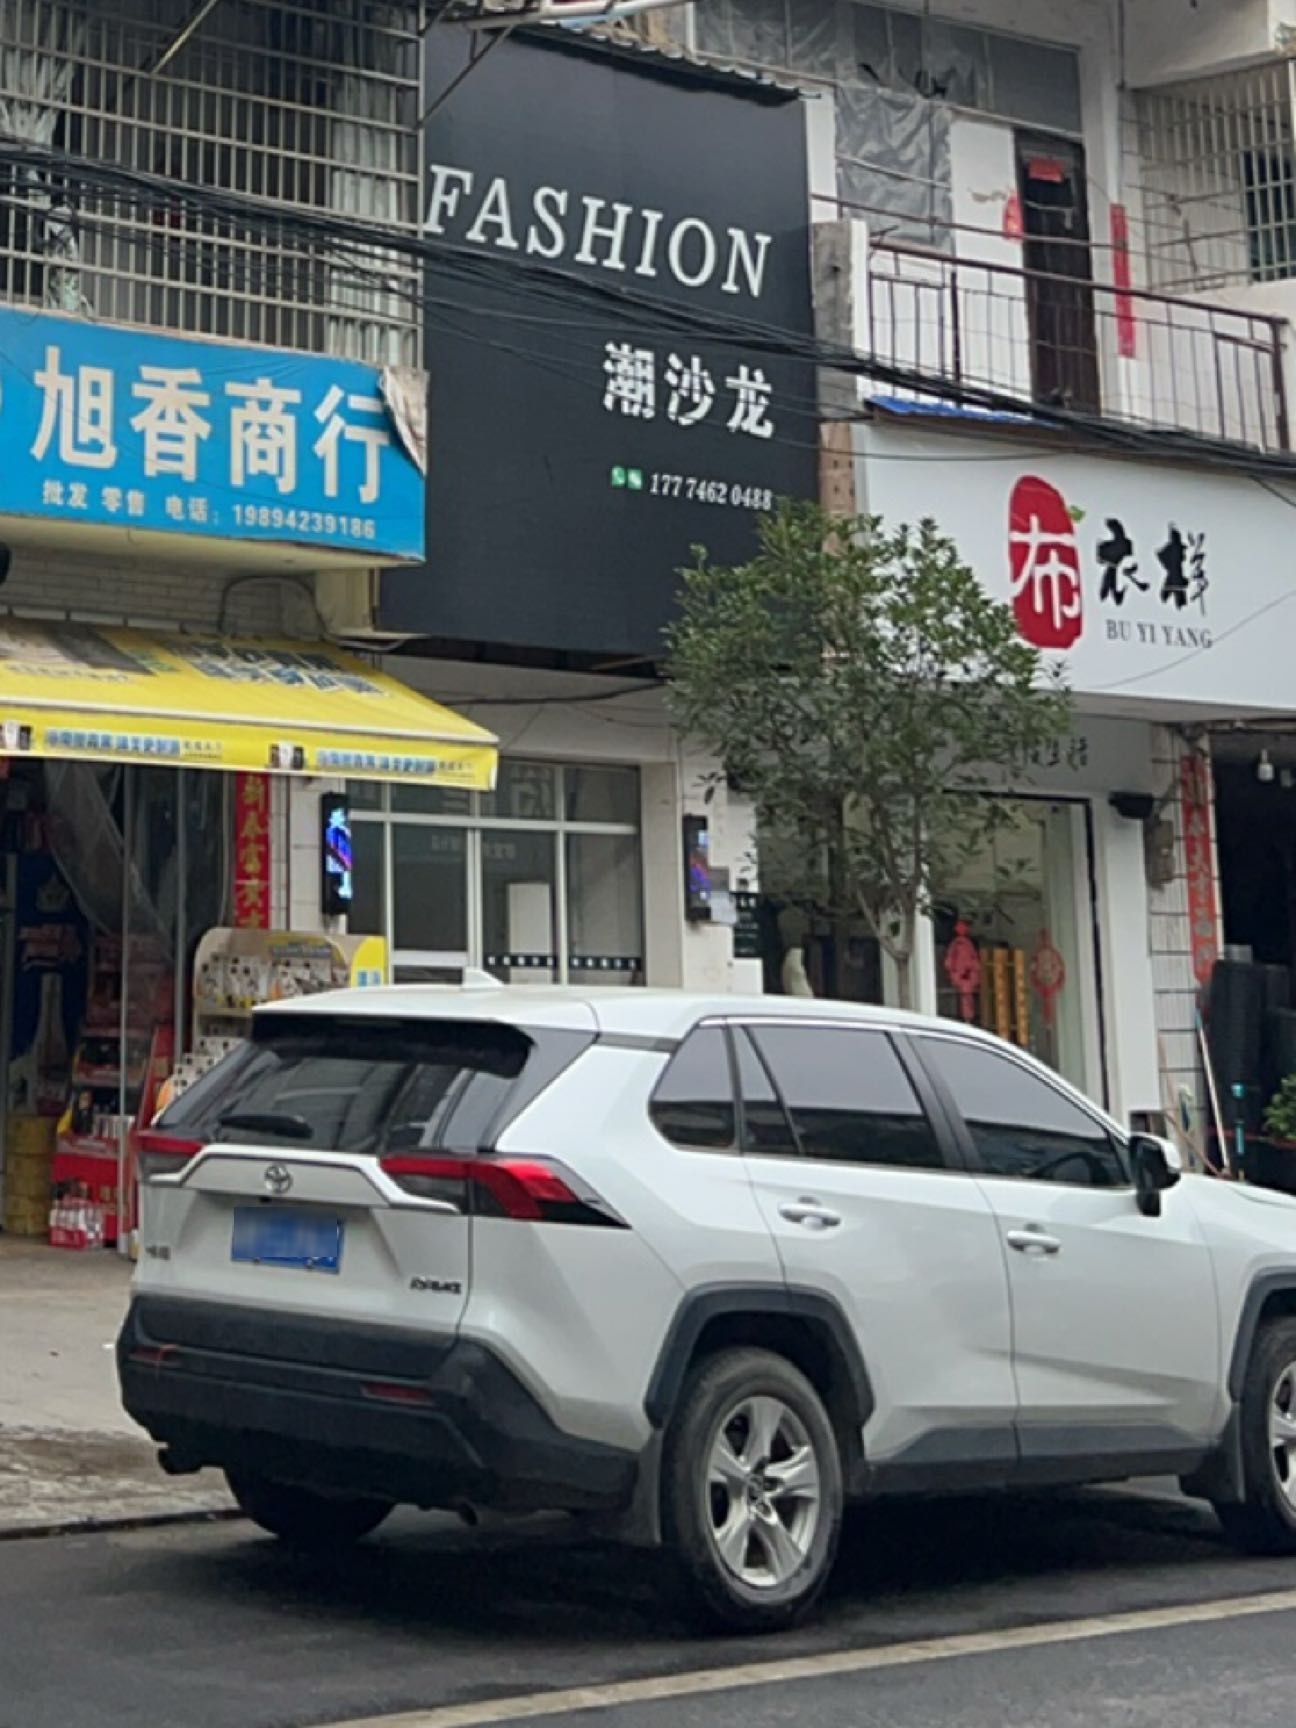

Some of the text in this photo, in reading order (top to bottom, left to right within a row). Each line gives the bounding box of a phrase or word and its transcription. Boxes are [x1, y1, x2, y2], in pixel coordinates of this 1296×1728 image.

[423, 164, 773, 298] FASHION
[30, 345, 390, 504] 旭香商行
[604, 341, 775, 439] 潮沙龙
[43, 479, 88, 510] 批发
[102, 487, 145, 517] 零售
[1106, 619, 1213, 649] BU YI YANG
